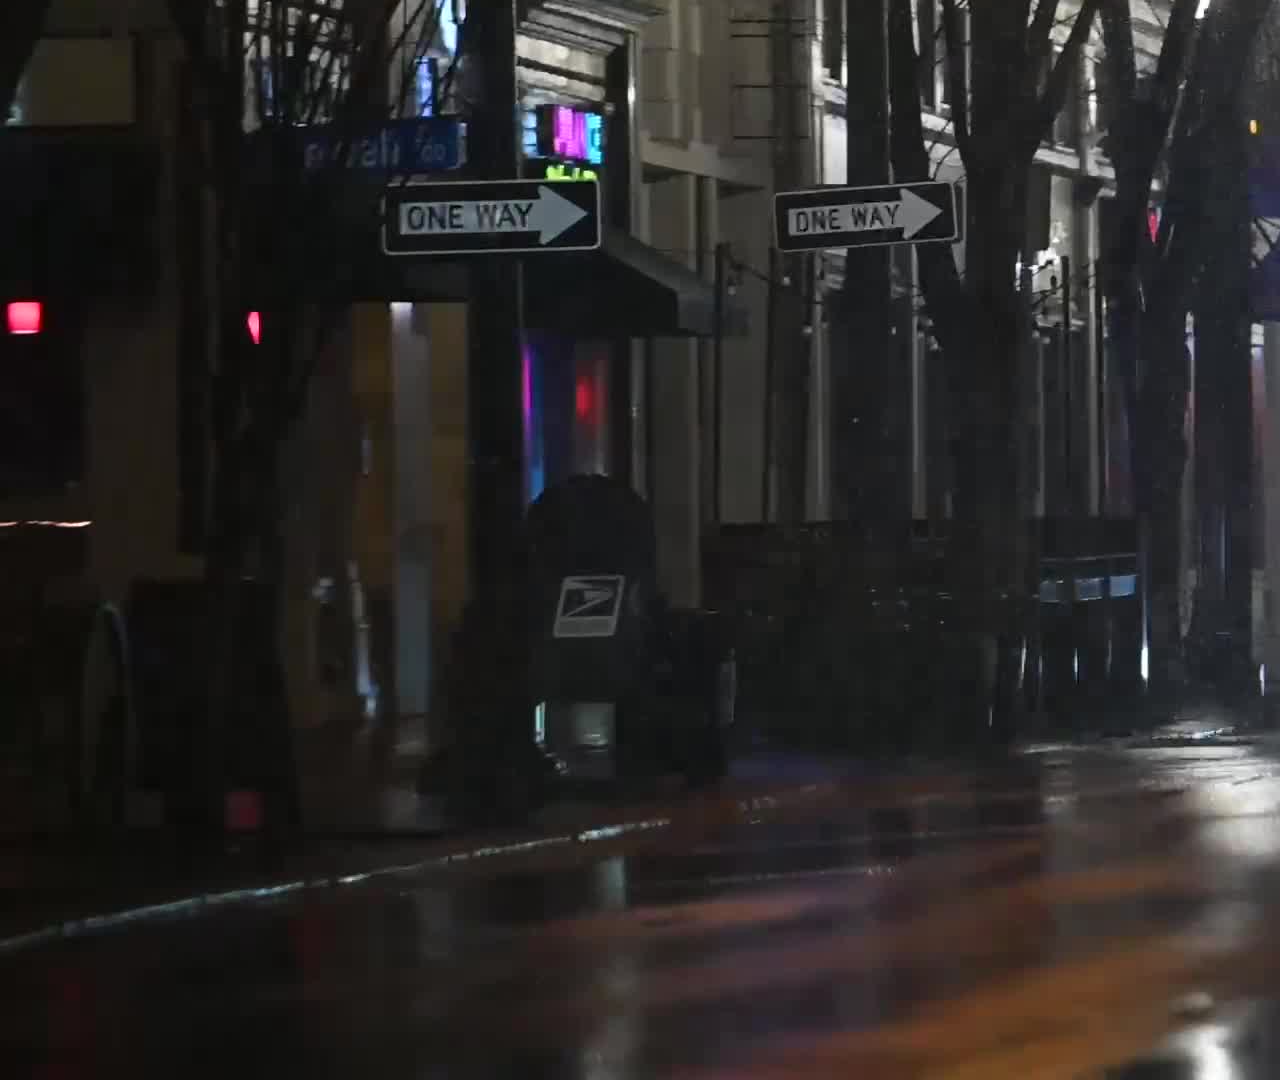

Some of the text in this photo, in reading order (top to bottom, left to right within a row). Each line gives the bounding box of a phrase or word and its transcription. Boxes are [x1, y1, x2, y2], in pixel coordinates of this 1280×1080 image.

[407, 202, 533, 230] ONE WAY
[795, 203, 900, 232] ONE WAY
